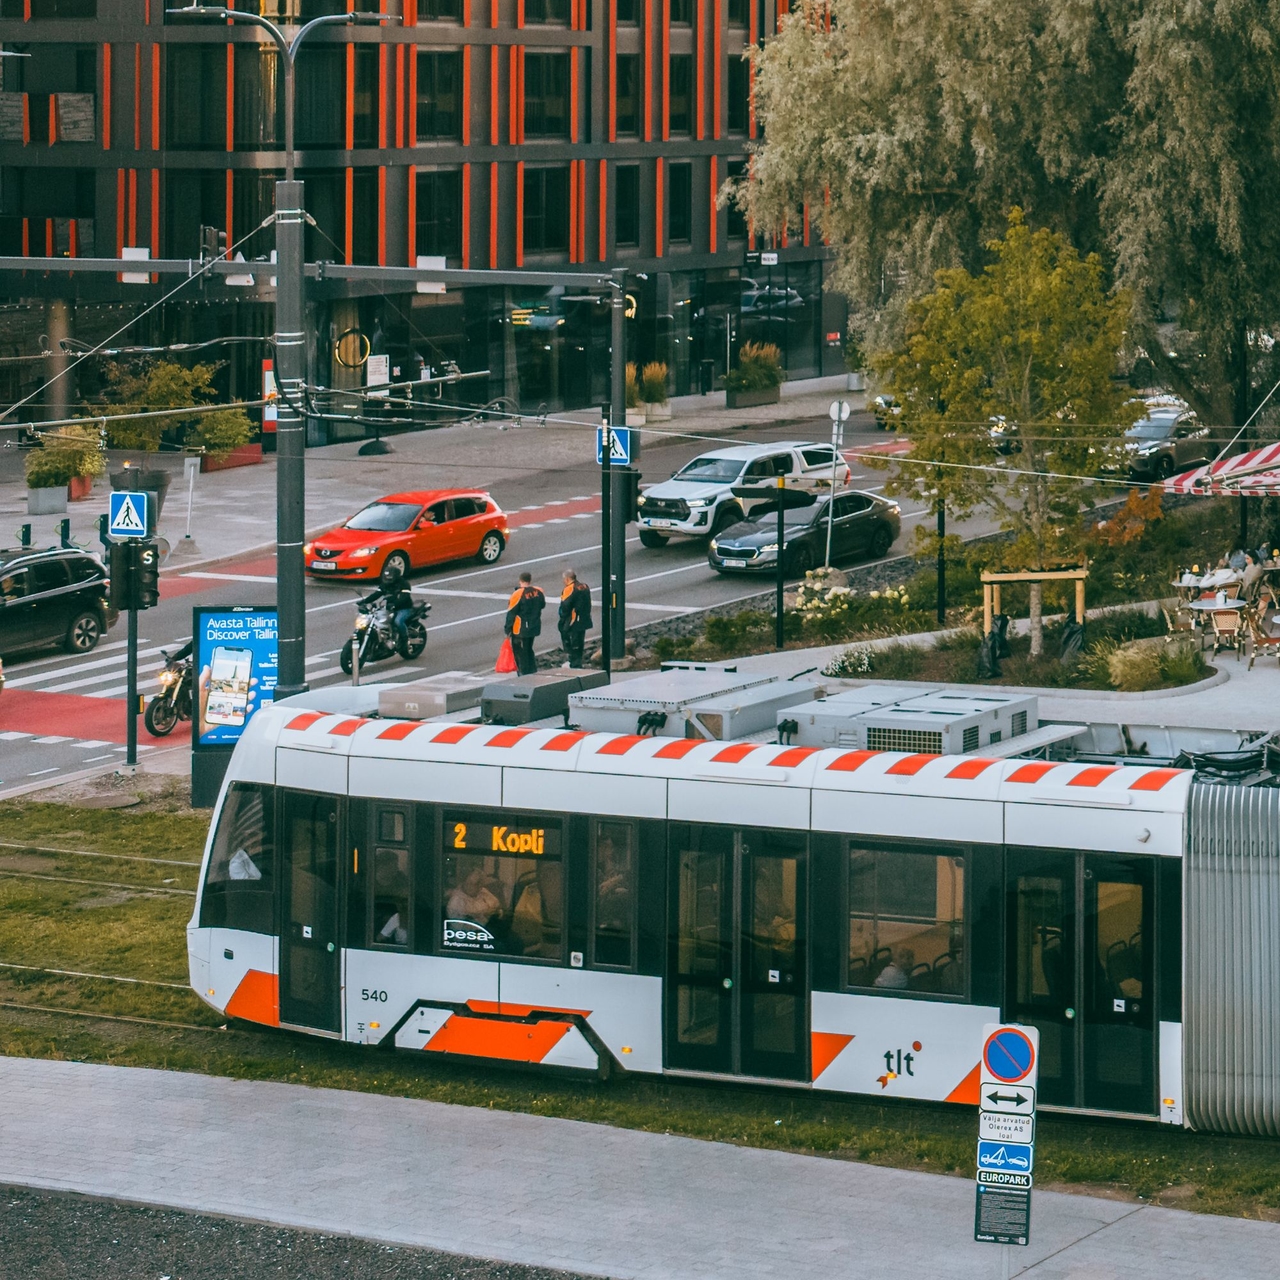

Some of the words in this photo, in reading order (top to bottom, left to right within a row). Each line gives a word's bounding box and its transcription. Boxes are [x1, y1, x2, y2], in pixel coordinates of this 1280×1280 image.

[207, 618, 243, 629] Avasta
[245, 616, 278, 628] Tallinn
[206, 629, 251, 641] Discover
[253, 628, 278, 640] Tallin
[454, 823, 467, 849] 2
[492, 826, 545, 854] Kopli
[444, 929, 488, 941] pesa
[361, 989, 388, 1003] 540
[883, 1048, 914, 1077] tlt
[988, 1123, 1012, 1131] Olerex
[980, 1172, 1028, 1185] EUROPARK
